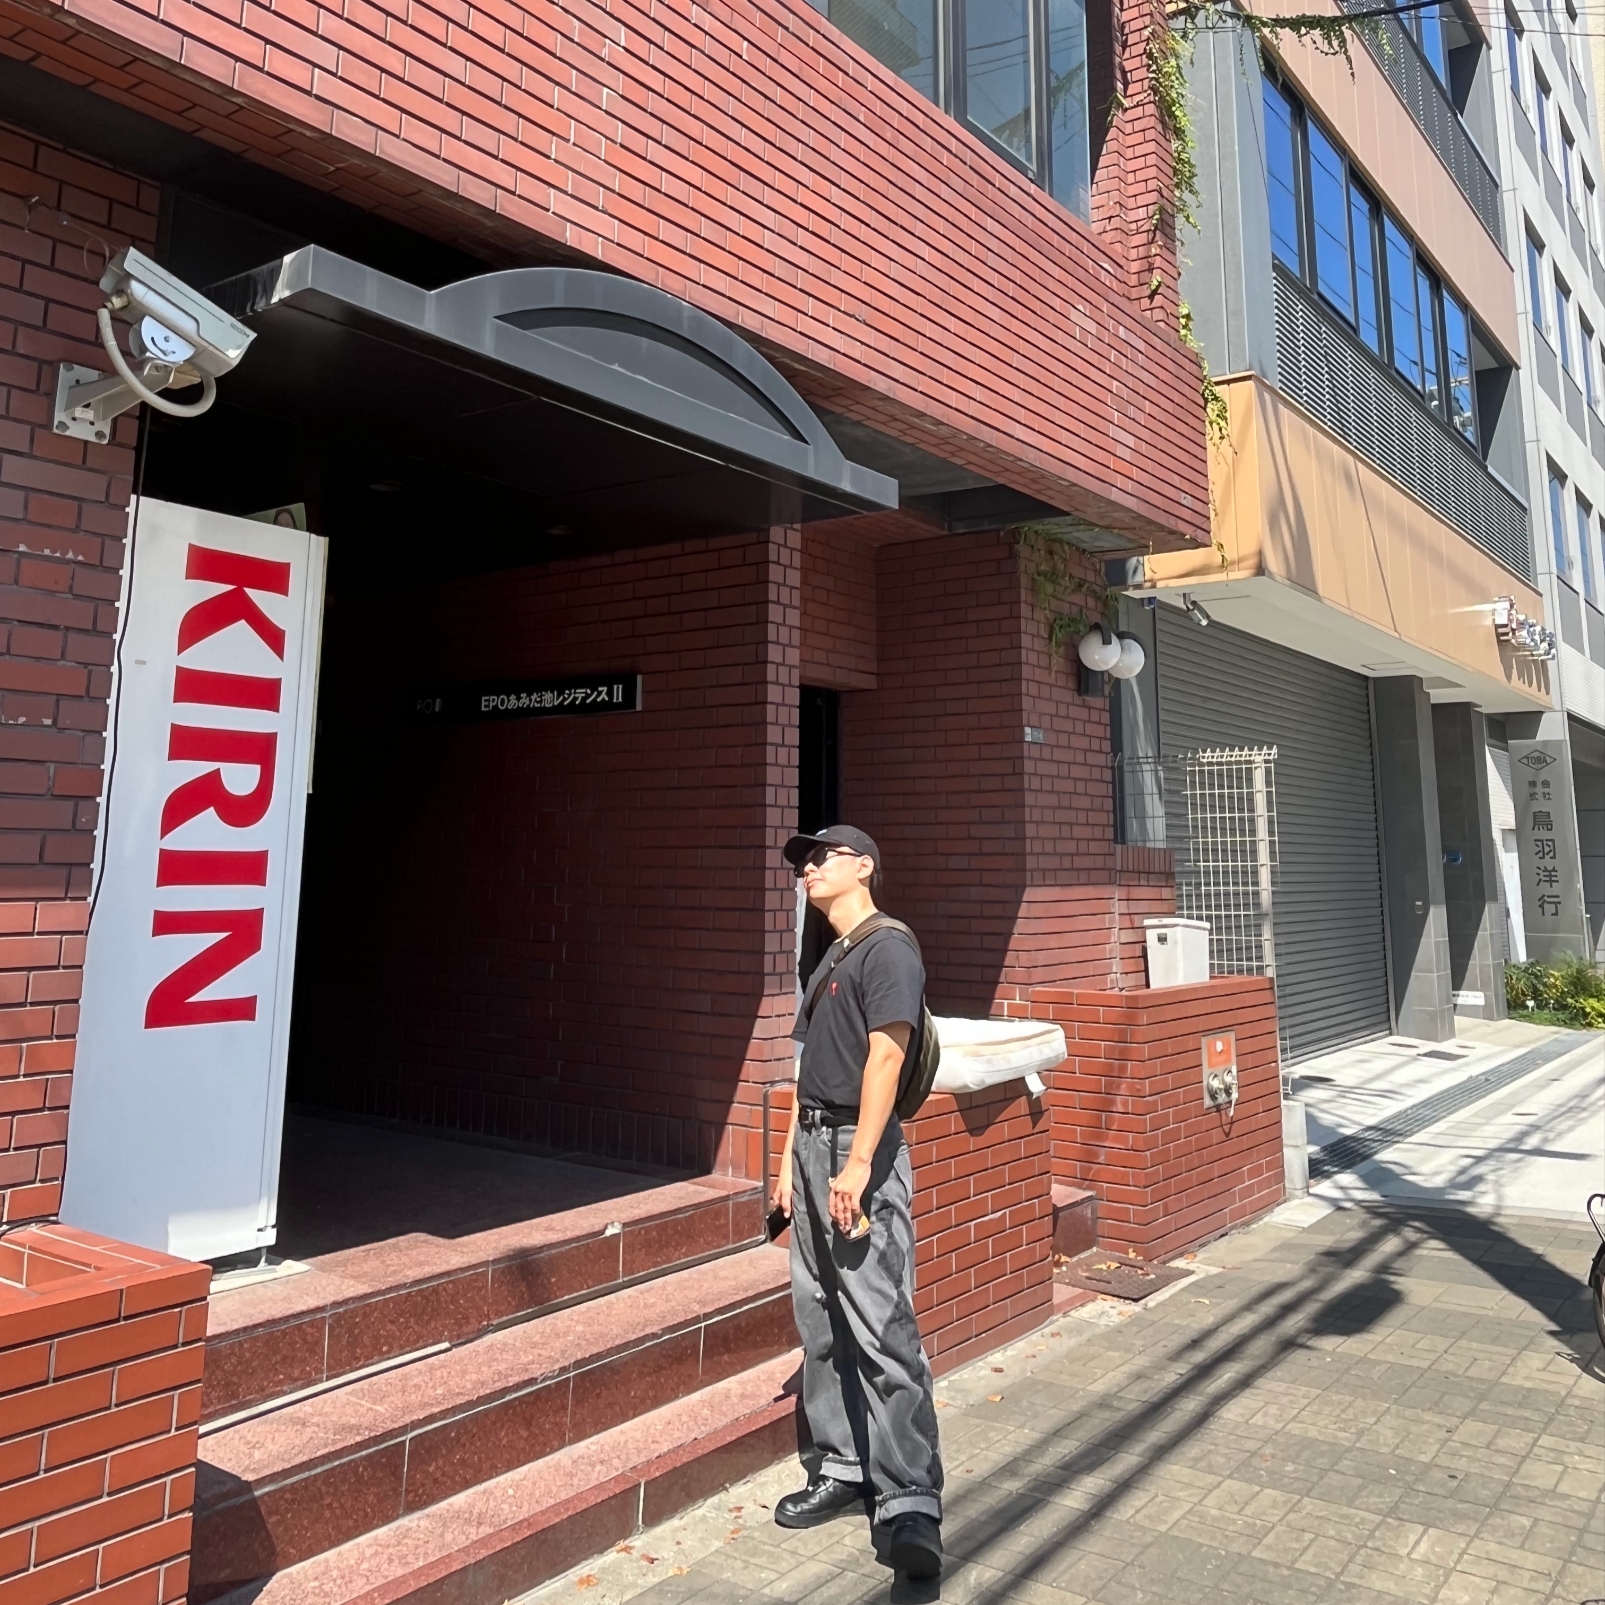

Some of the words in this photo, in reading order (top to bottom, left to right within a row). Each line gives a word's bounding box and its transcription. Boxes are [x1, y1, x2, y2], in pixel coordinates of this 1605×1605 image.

[144, 543, 291, 1030] KIRIN
[1526, 756, 1548, 765] TOBA
[1531, 810, 1562, 917] 鳥羽洋行
